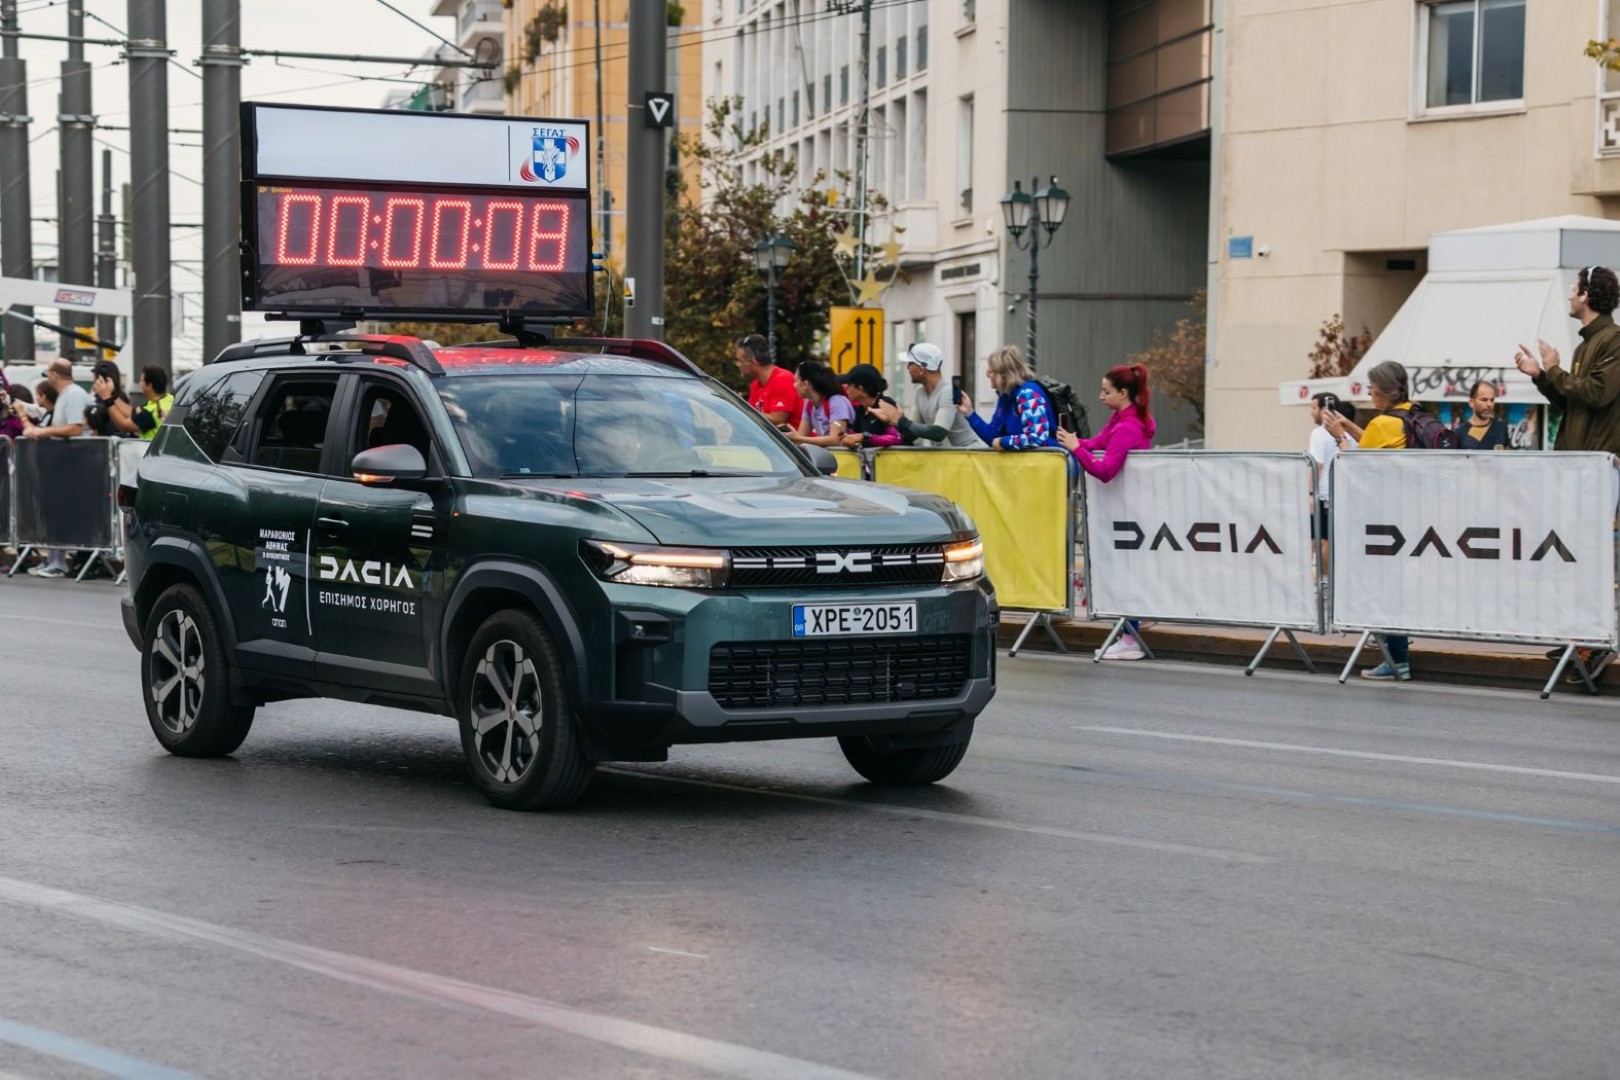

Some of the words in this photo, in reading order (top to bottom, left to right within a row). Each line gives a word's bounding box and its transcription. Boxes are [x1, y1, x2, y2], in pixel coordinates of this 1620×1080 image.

[532, 127, 565, 137] ΣΕΓΑΣ
[278, 194, 570, 271] 00:00:08
[1113, 521, 1283, 554] DACIA
[1365, 524, 1577, 563] DACIA
[320, 555, 414, 589] DACIA
[319, 591, 367, 608] ΕΠΙΣΗΜΟΣ
[370, 597, 415, 615] ΧΟΡΗΓΟΣ
